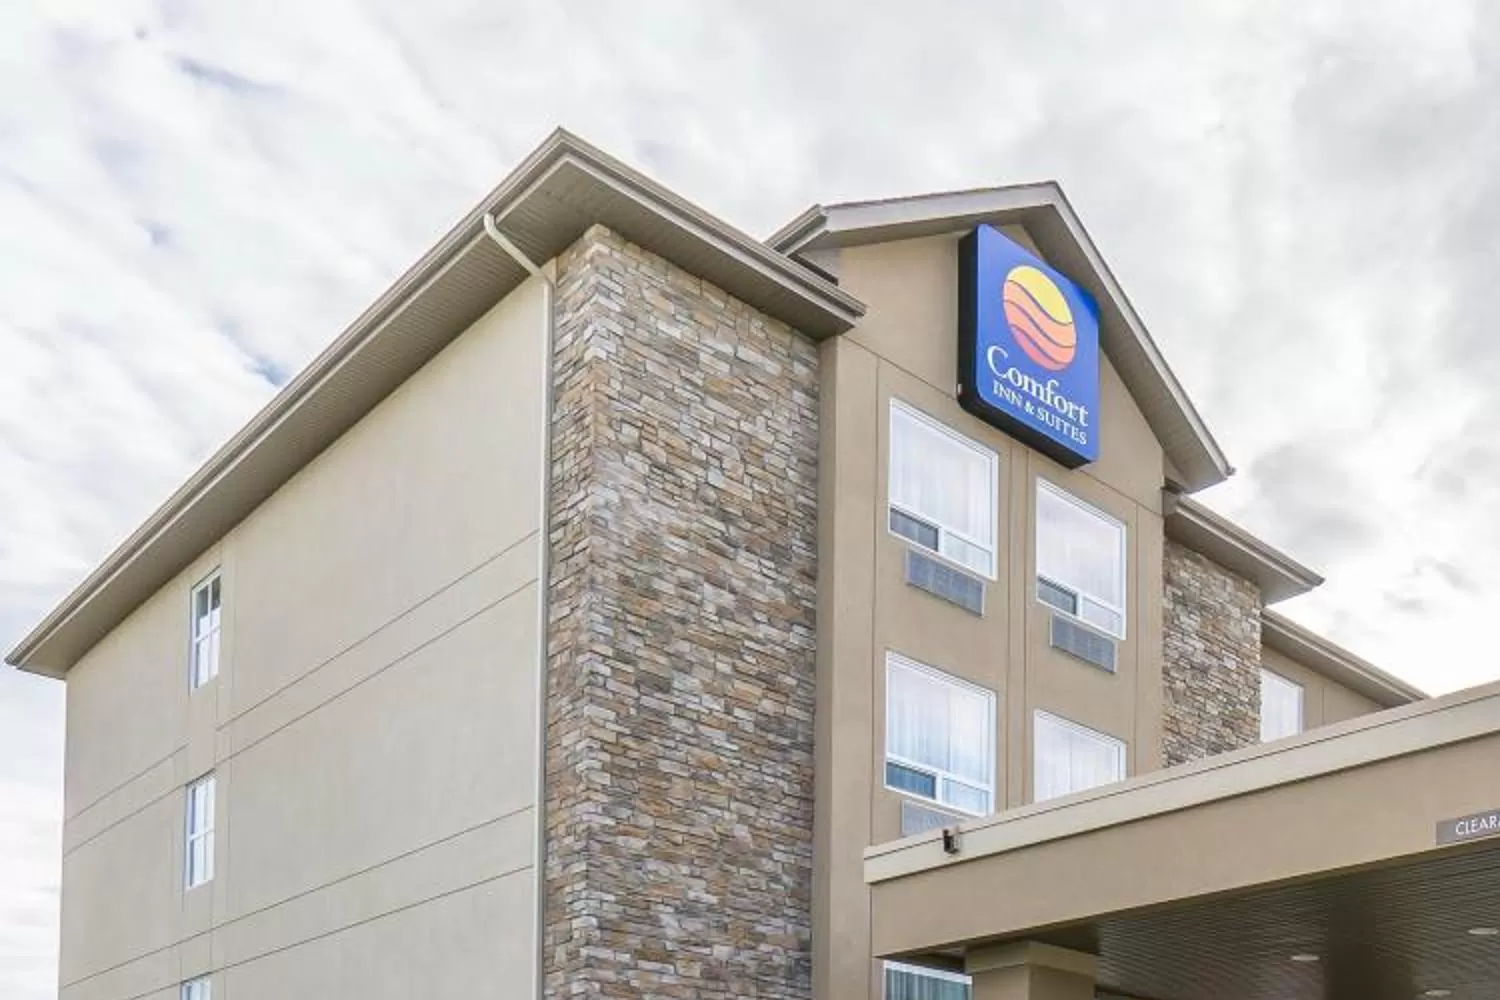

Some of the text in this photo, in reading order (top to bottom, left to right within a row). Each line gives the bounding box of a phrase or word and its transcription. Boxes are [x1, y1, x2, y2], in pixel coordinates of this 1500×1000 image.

[987, 345, 1088, 426] Comfort
[993, 380, 1087, 446] INN & SUITES
